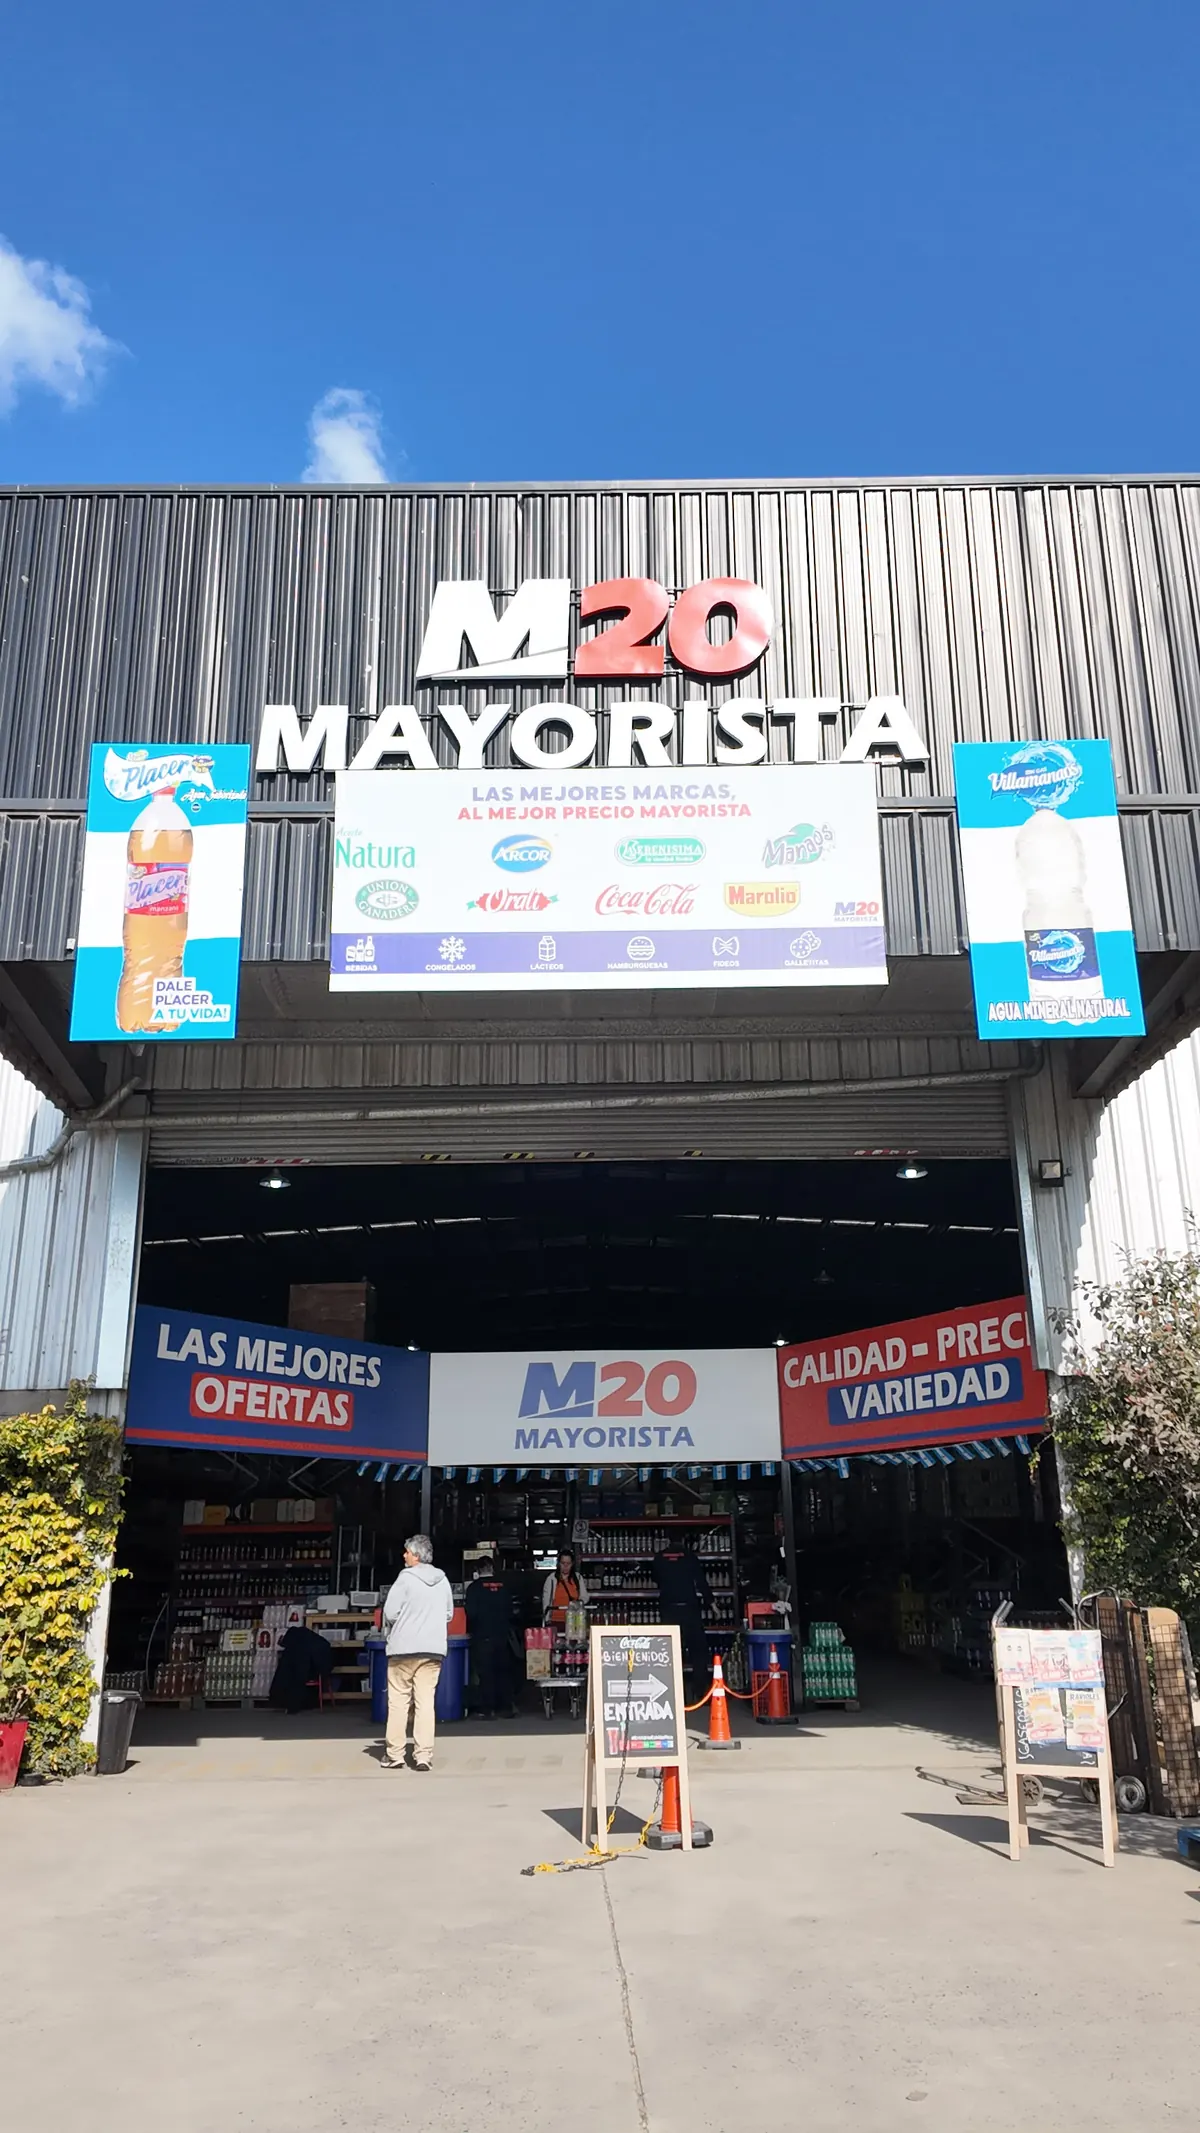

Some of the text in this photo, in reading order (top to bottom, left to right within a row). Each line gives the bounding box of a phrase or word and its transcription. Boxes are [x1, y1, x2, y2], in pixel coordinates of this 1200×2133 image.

[415, 577, 774, 681] M20
[255, 695, 930, 772] MAYORISTA
[121, 759, 189, 792] Placer
[988, 763, 1082, 791] Villamanaos
[472, 784, 736, 802] LAS MEJORES MARCAS,
[458, 804, 751, 820] AL MEJOR PRECIO MAYORISTA
[335, 838, 416, 868] Natura
[493, 847, 550, 861] ARCOR
[762, 823, 833, 868] Manaos
[366, 881, 409, 893] UNION
[728, 886, 797, 905] Marolio
[359, 901, 417, 919] GANADERA
[834, 902, 879, 916] M20
[156, 981, 192, 991] DALE
[155, 995, 209, 1005] PLACER
[988, 998, 1131, 1021] AGUA MINERAL NATURAL
[154, 1008, 227, 1019] A TU VIDA!
[157, 1324, 381, 1388] LAS MEJORES
[783, 1339, 902, 1389] CALIDAD
[518, 1360, 697, 1419] M20
[840, 1363, 1010, 1420] VARIEDAD
[195, 1377, 349, 1426] OFERTAS
[515, 1426, 694, 1450] MAYORISTA
[604, 1700, 674, 1721] ENTRADA
